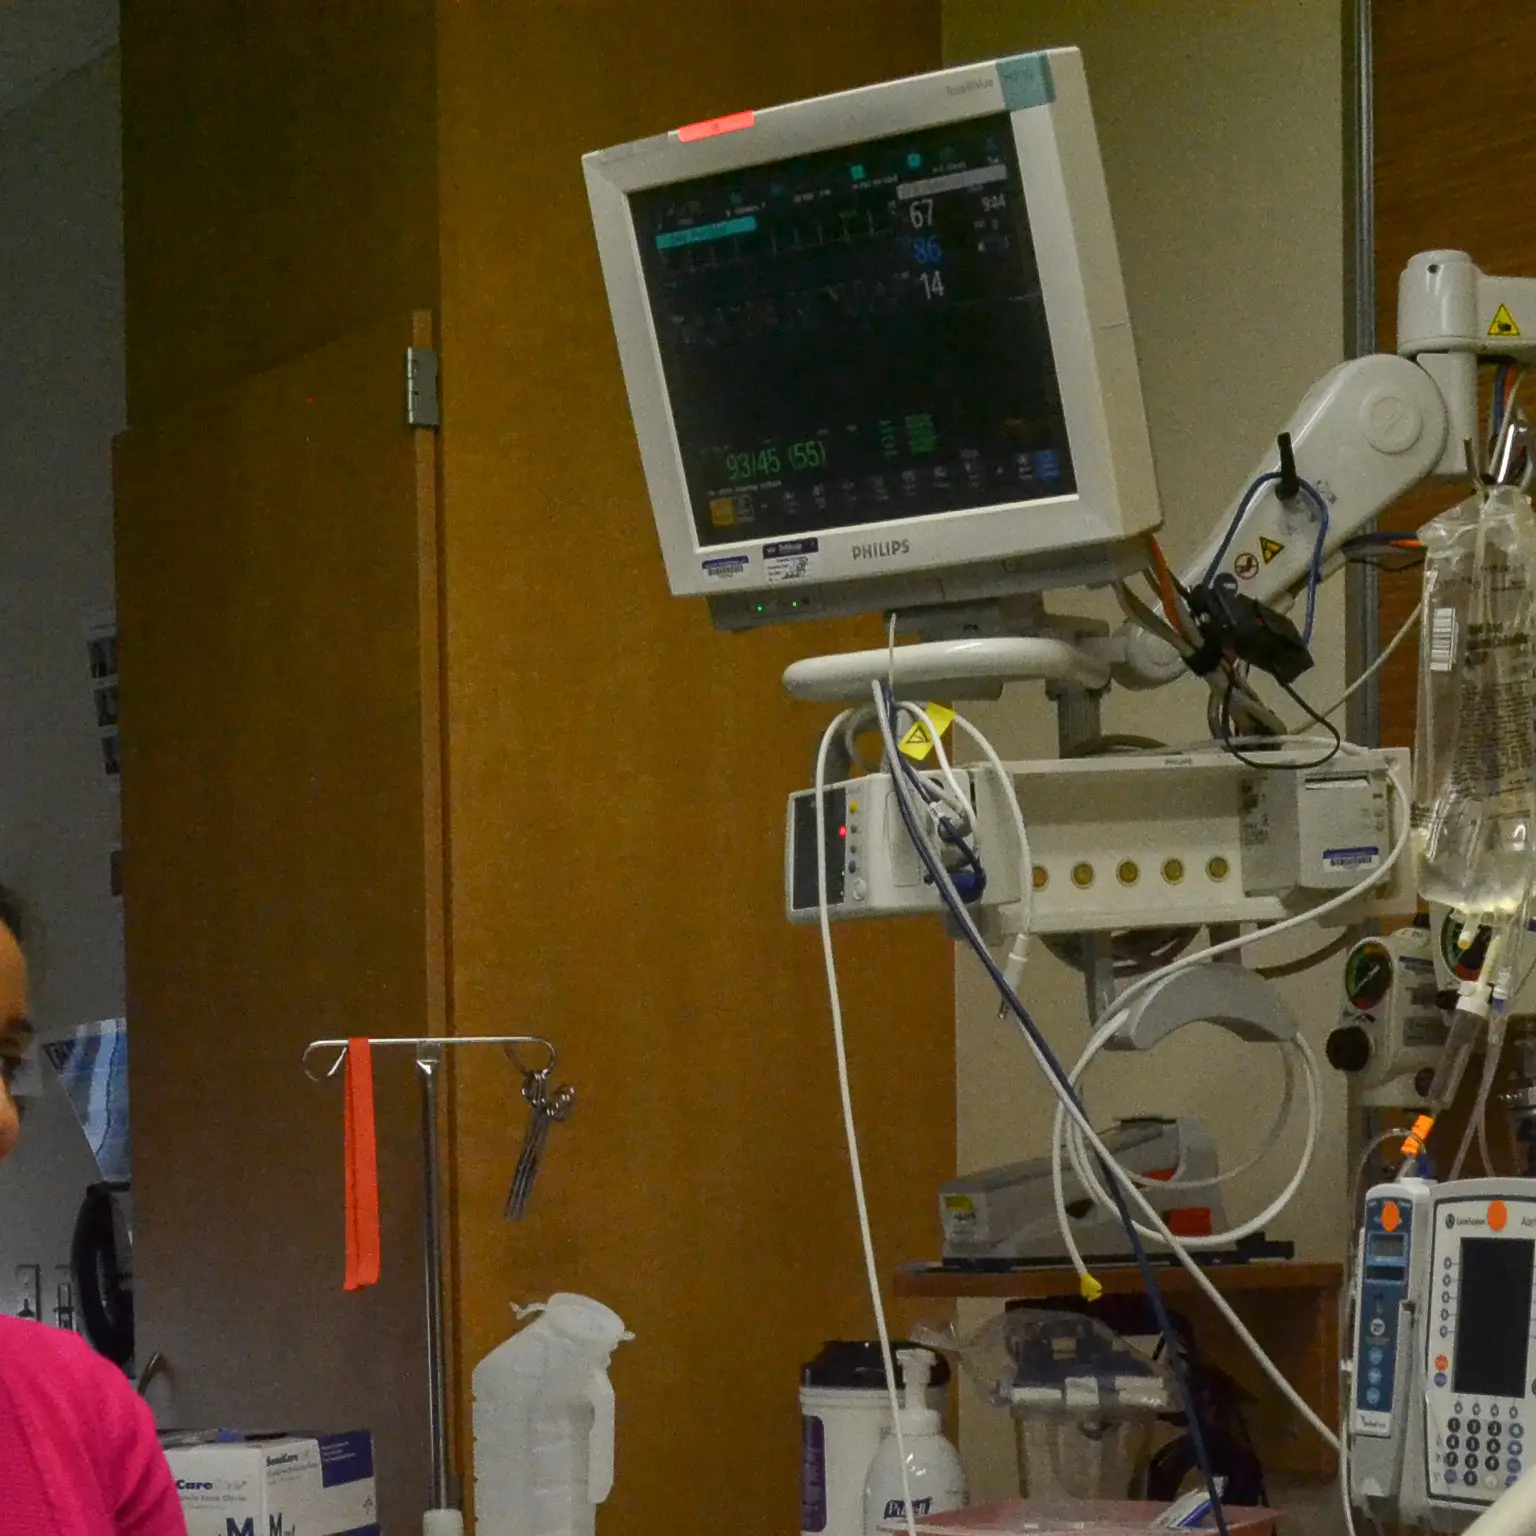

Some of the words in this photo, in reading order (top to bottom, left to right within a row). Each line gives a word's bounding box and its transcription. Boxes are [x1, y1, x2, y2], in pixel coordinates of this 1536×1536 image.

[909, 198, 934, 229] 67
[914, 234, 942, 265] 86
[920, 270, 944, 300] 14
[725, 448, 781, 480] 93/45
[788, 440, 827, 470] (55)
[851, 538, 911, 561] PHILIPS
